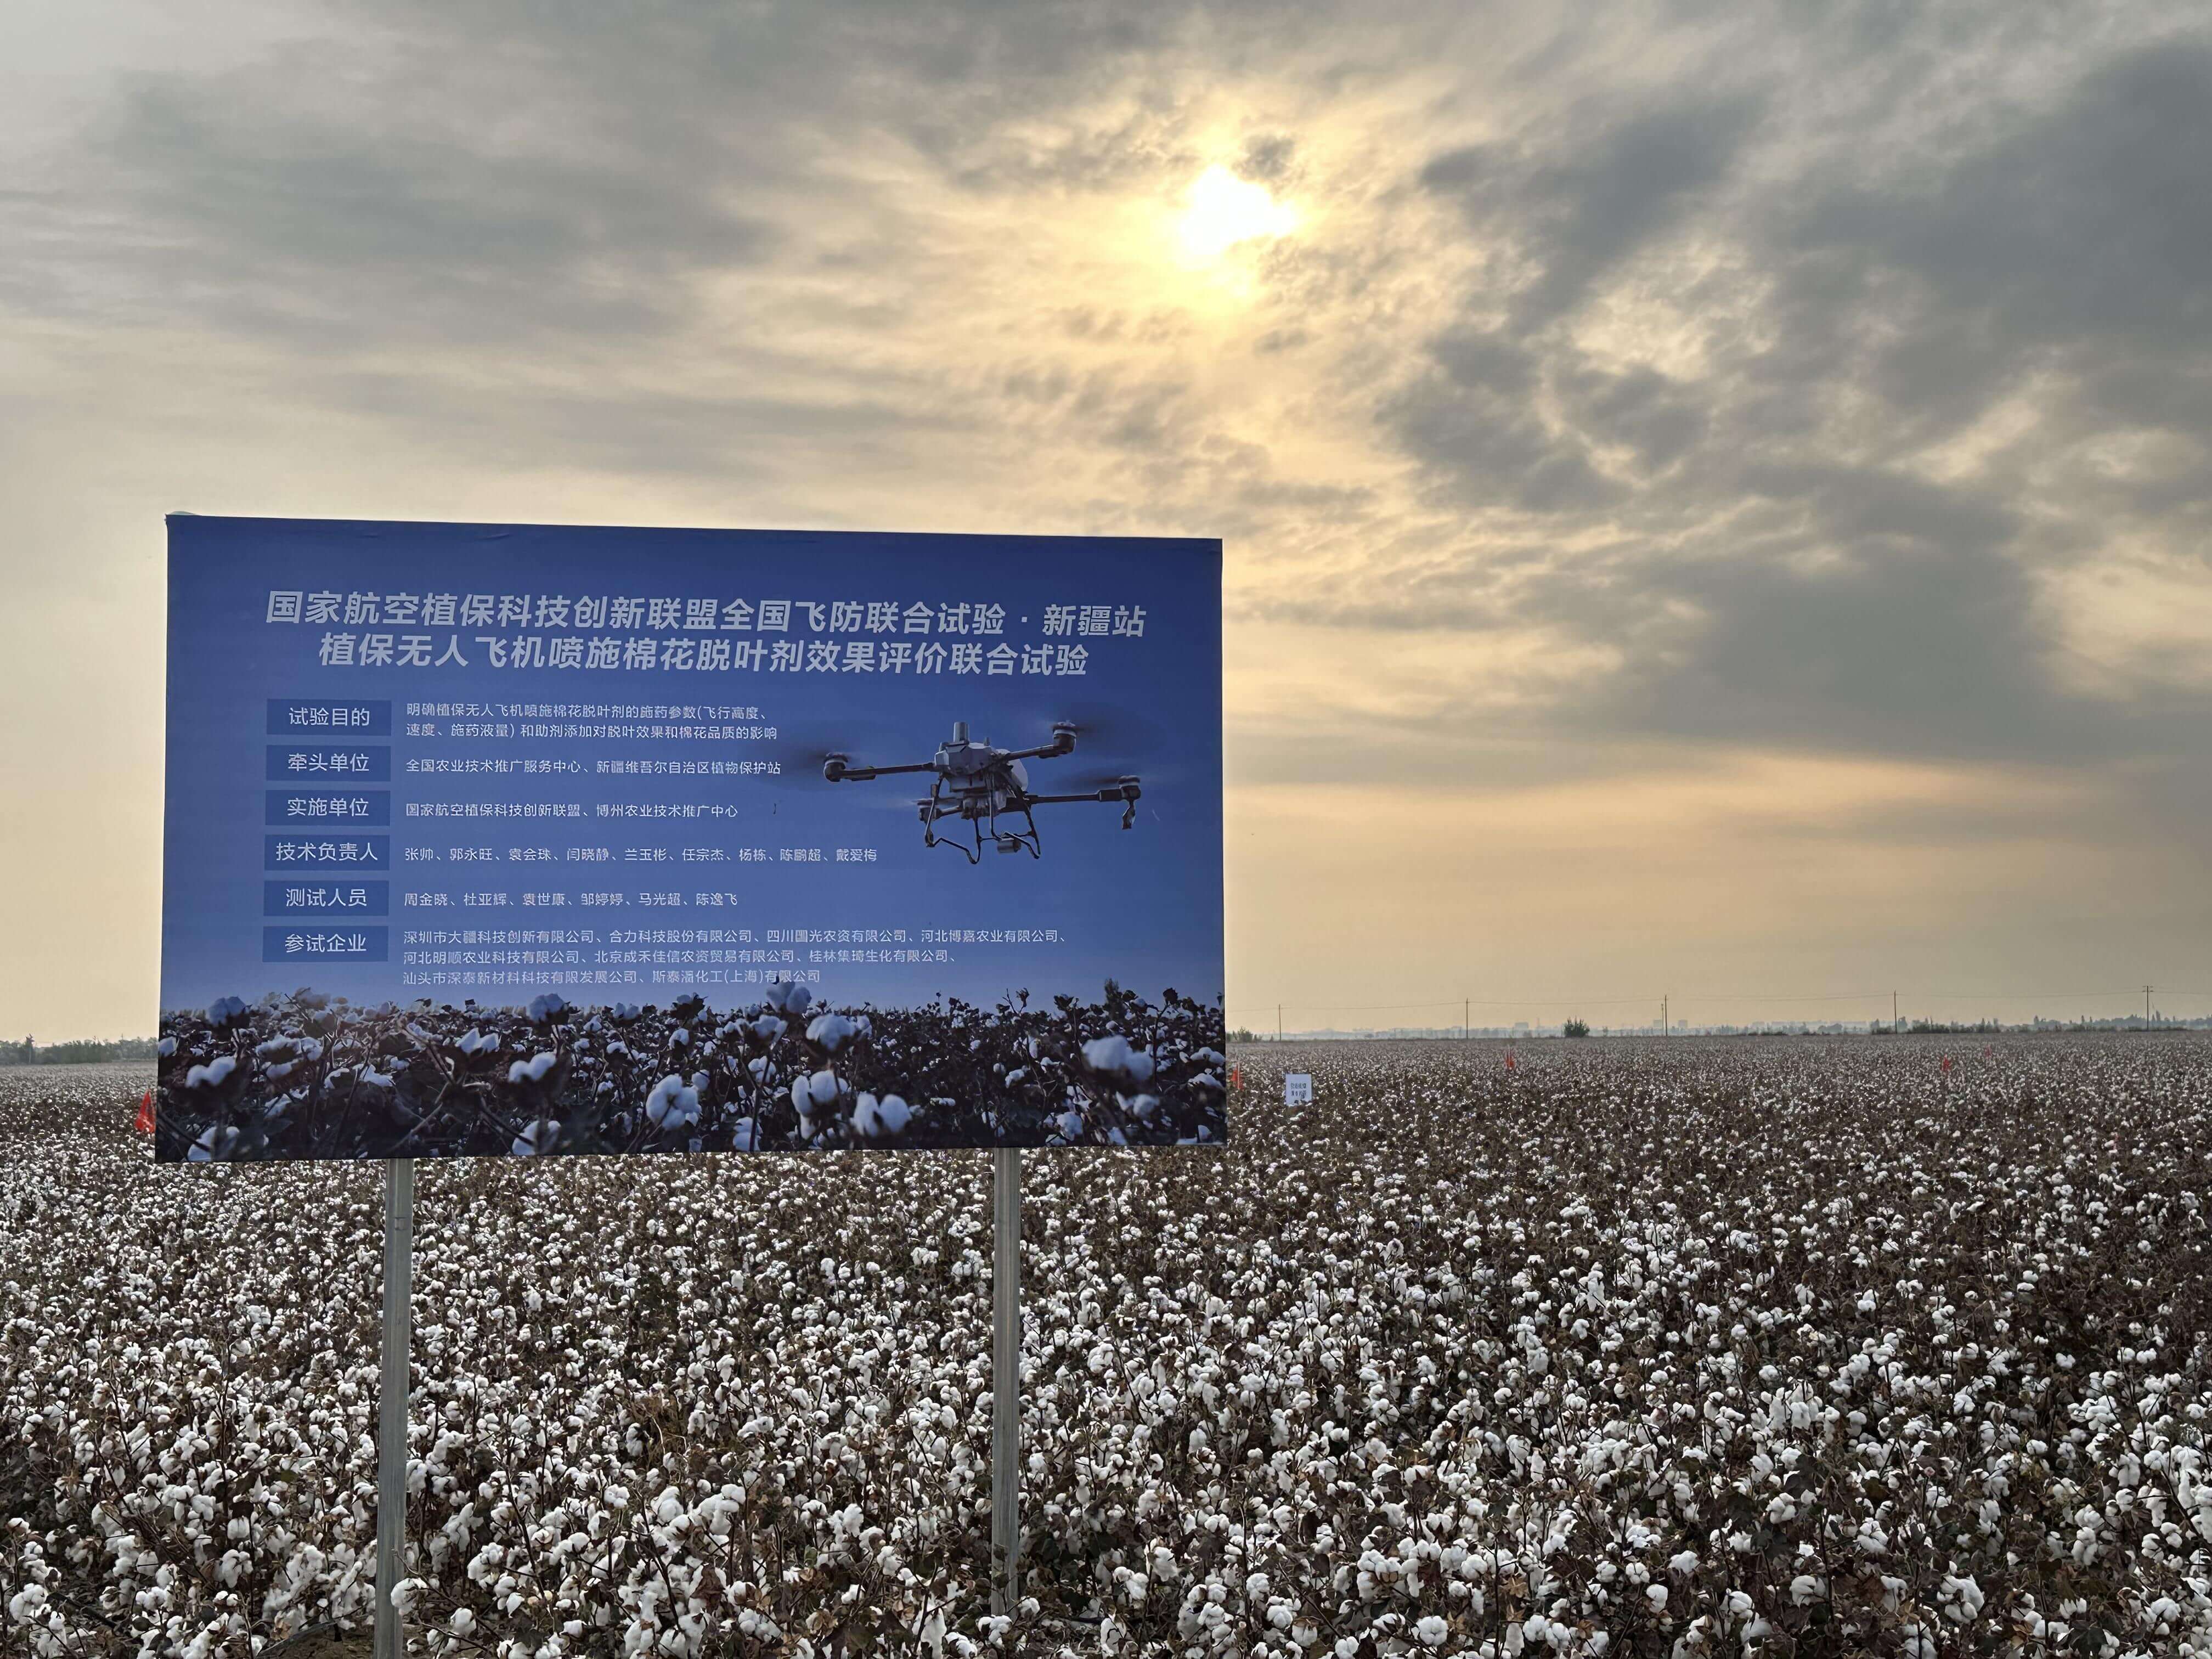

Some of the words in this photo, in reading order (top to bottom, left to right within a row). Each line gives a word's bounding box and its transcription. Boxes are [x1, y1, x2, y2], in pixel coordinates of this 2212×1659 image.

[319, 631, 1090, 676] 植保无人飞机喷施棉花脱叶剂效果评价联合试验
[289, 707, 370, 726] 试验目的
[287, 753, 370, 772] 牵头单位
[287, 797, 369, 817] 实施单位
[406, 803, 738, 818] 国家航空植保科技创新联盟、博州农业技术推广中心
[275, 842, 378, 861] 技术负责人
[286, 888, 368, 907] 测试人员
[284, 933, 367, 953] 参试企业
